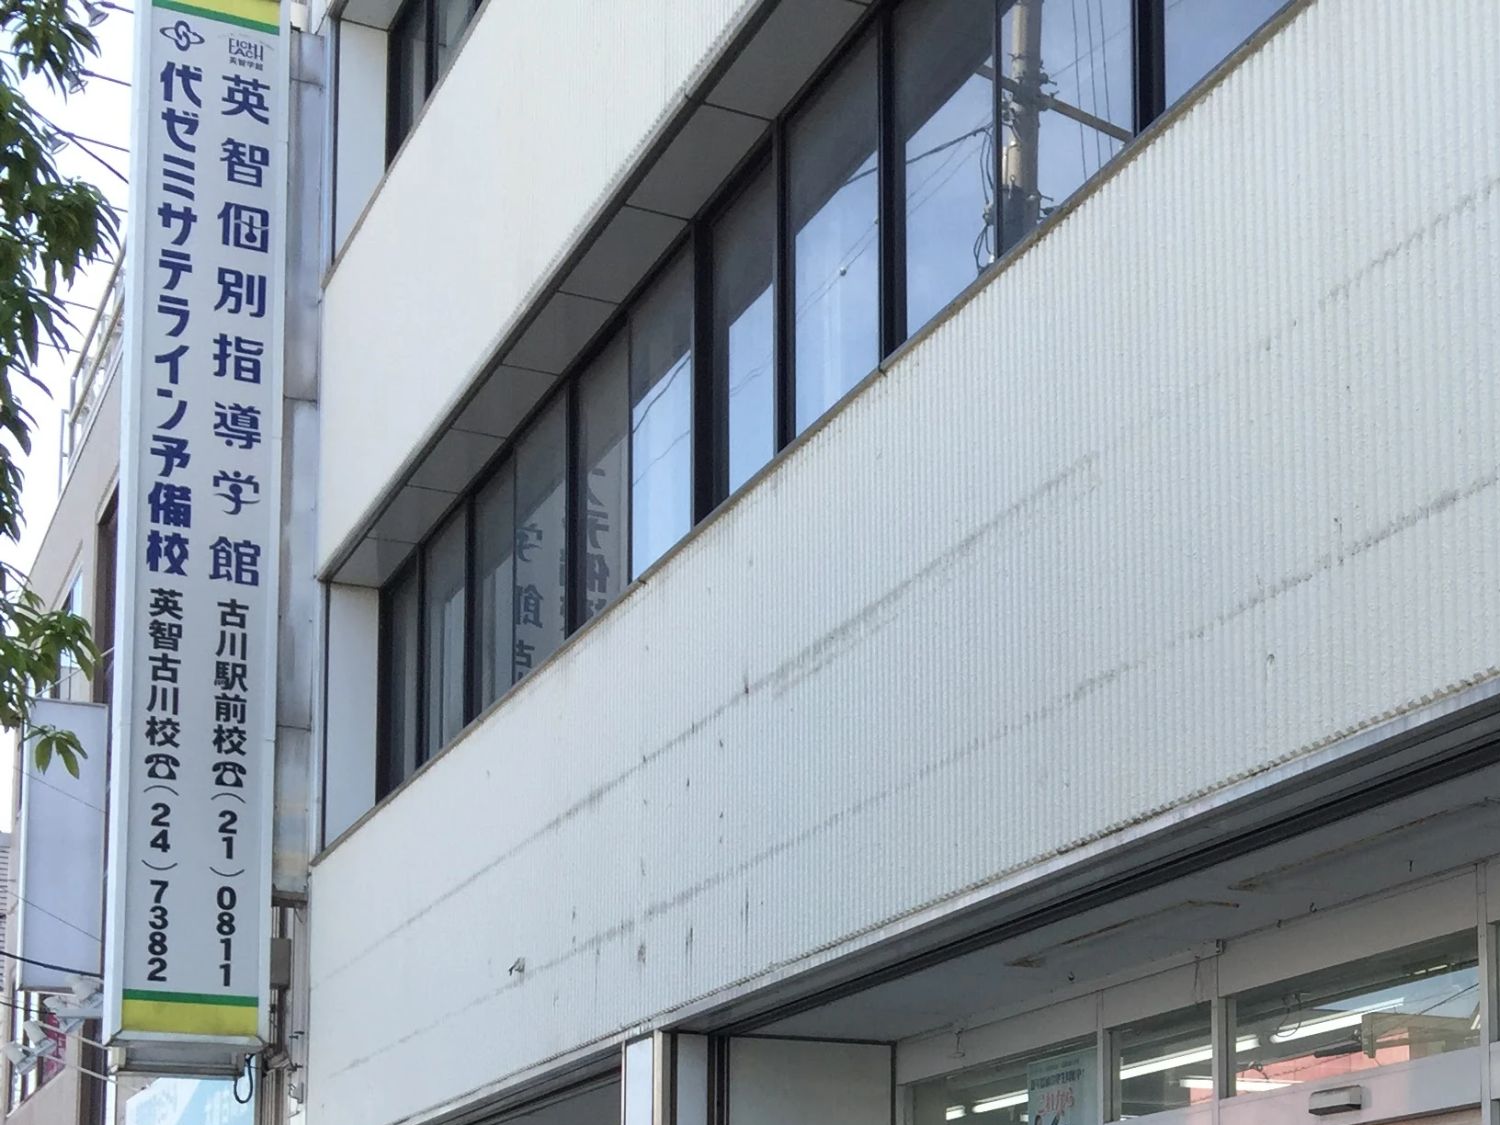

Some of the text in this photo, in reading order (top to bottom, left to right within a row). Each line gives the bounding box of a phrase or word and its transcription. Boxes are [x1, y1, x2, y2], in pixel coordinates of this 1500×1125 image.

[146, 60, 203, 577] 代ゼミサテライン予備校
[208, 73, 271, 587] 英智個別指導学館
[144, 588, 183, 748] 英智古川校
[212, 599, 249, 756] 古川駅前校
